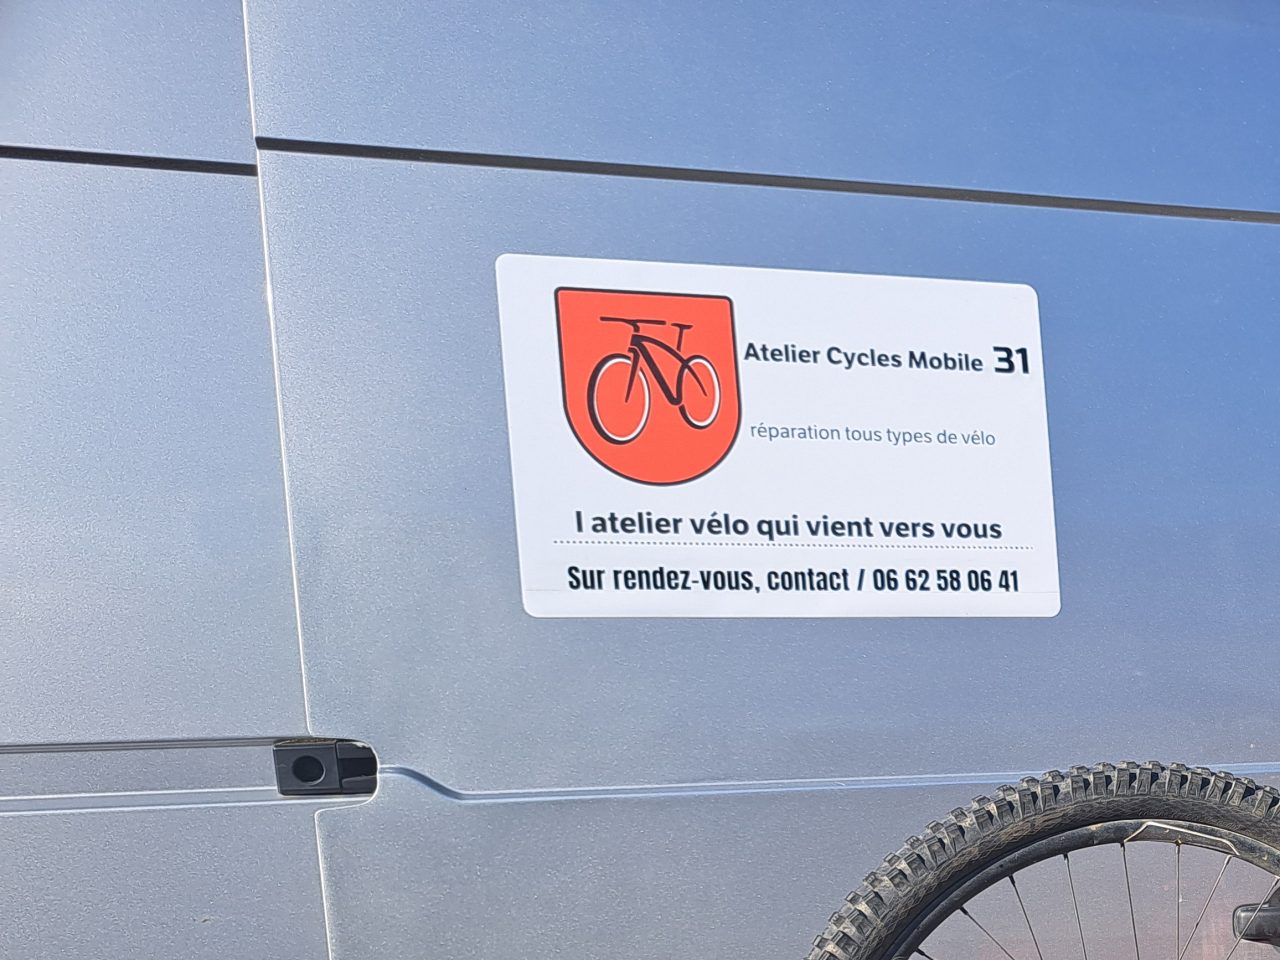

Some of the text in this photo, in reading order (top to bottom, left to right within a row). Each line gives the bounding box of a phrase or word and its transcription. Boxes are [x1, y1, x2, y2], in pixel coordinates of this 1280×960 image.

[743, 342, 1030, 375] Atelier Cycles Mobile 31
[750, 421, 996, 447] réparation tous types de vélo
[591, 511, 683, 535] atelier
[689, 511, 750, 536] vélo
[756, 514, 799, 542] qui
[805, 514, 874, 538] vient
[878, 521, 935, 539] vers
[940, 522, 1003, 540] vous
[567, 565, 1019, 594] Sur rendez-vous, contact / 06 62 58 06 41
